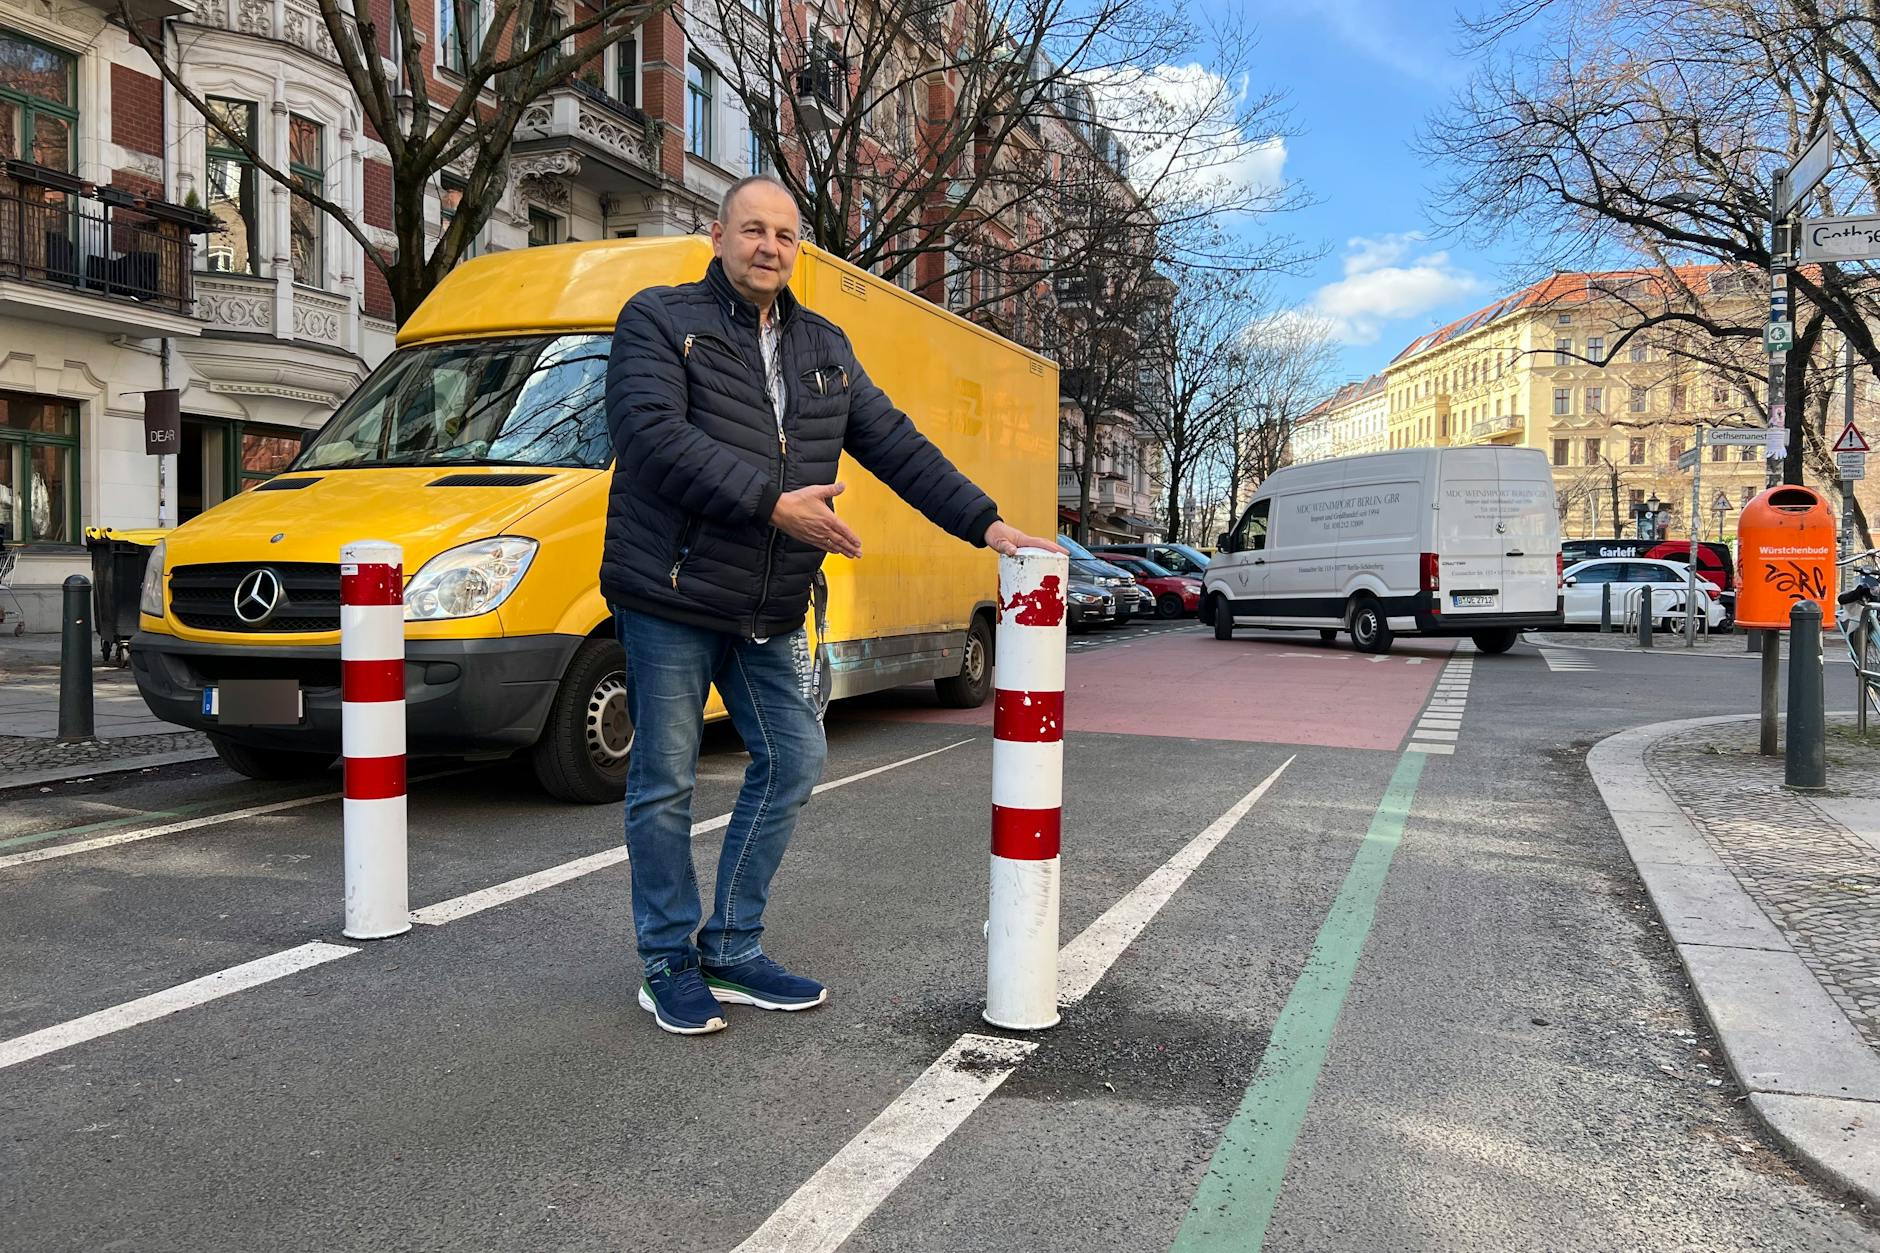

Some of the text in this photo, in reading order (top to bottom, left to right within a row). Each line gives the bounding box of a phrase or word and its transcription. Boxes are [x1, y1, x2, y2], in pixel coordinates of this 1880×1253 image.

[151, 430, 175, 442] DEAR
[1296, 504, 1310, 514] MDC
[1357, 495, 1382, 507] BERLIN
[1384, 493, 1400, 504] GBR
[1600, 547, 1637, 557] Garleff
[1759, 546, 1829, 554] Würstchenbude
[1476, 596, 1493, 604] 2712
